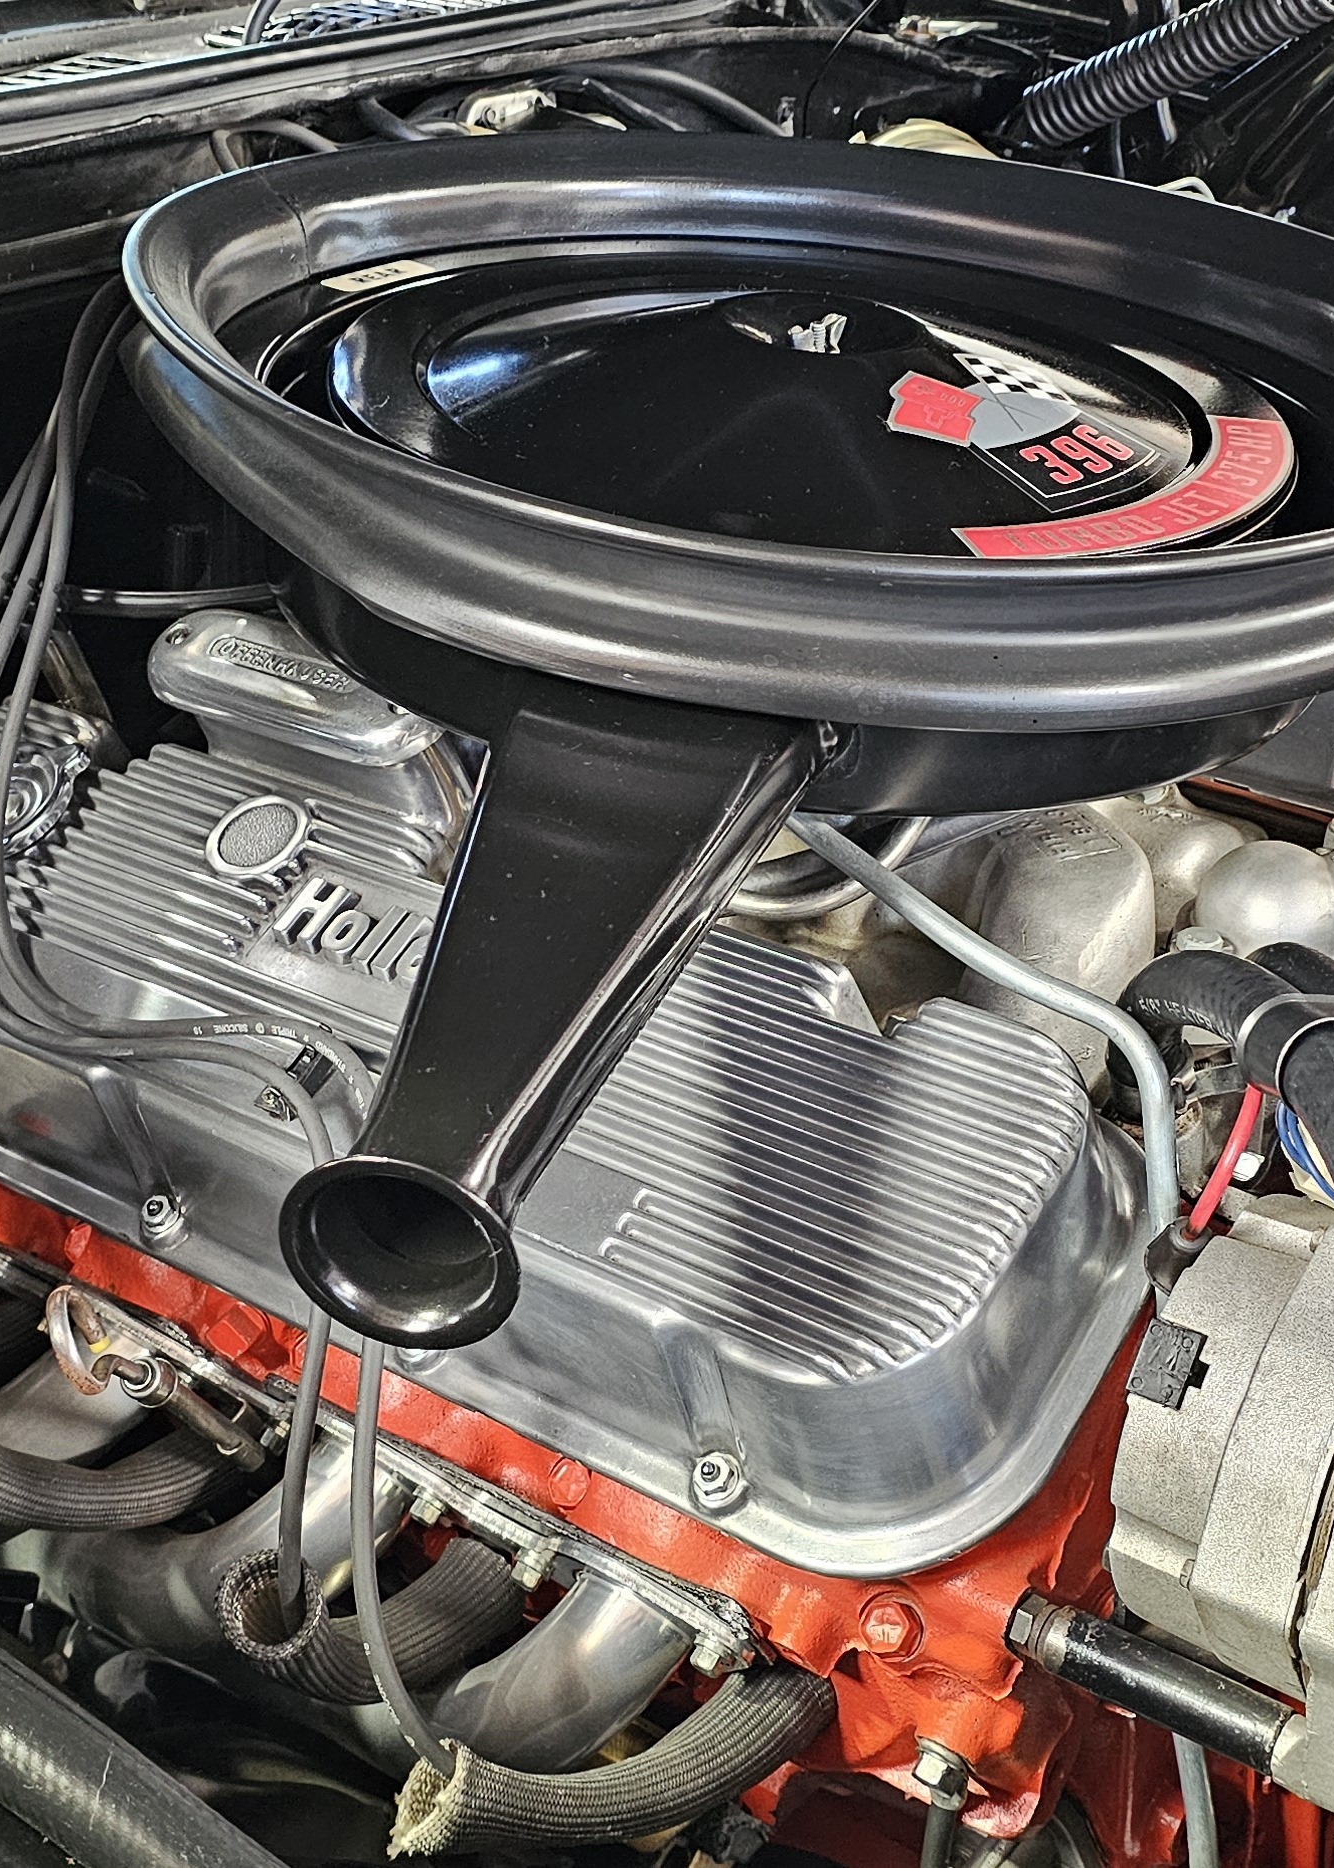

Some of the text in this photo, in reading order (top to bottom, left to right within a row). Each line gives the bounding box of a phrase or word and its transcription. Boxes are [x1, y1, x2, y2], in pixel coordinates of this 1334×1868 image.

[347, 267, 408, 284] REAR
[1019, 424, 1134, 485] 396
[272, 877, 434, 983] Holle
[212, 1023, 249, 1035] SILICONE
[271, 1024, 298, 1039] TRIPLE
